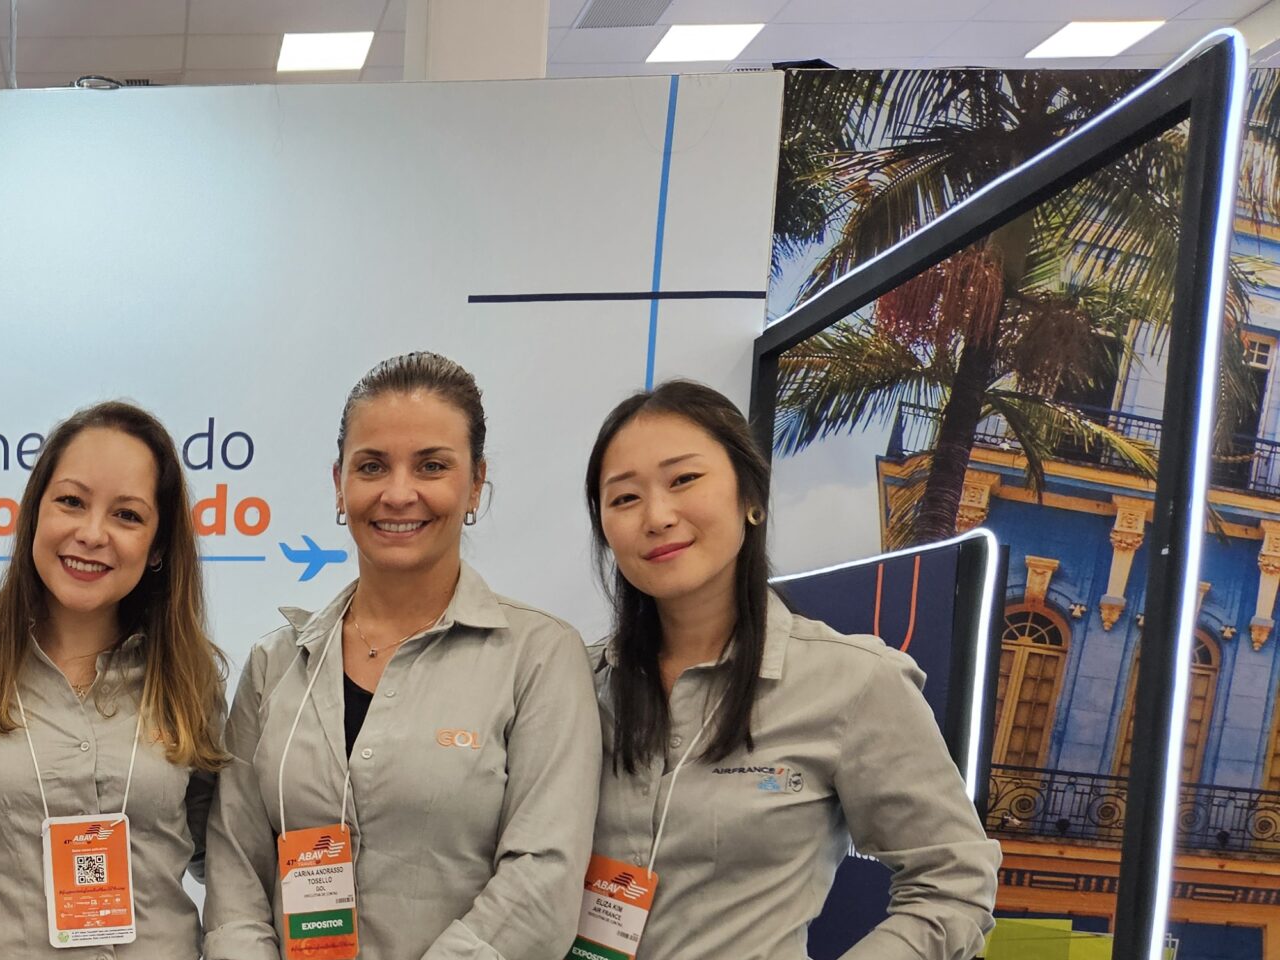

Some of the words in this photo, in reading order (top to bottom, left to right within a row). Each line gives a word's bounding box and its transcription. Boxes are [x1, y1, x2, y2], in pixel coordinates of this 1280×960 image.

[712, 766, 776, 775] AIRFRANCE
[73, 834, 94, 842] ABAV
[298, 850, 324, 861] ABAV
[294, 869, 315, 878] CARINA
[308, 877, 333, 885] TOSELLO
[593, 879, 620, 894] ABAV
[595, 898, 612, 909] ELIZA
[612, 903, 624, 913] KIM
[592, 906, 603, 914] AIR
[602, 909, 622, 922] FRANCE
[302, 919, 343, 930] EXPOSITOR
